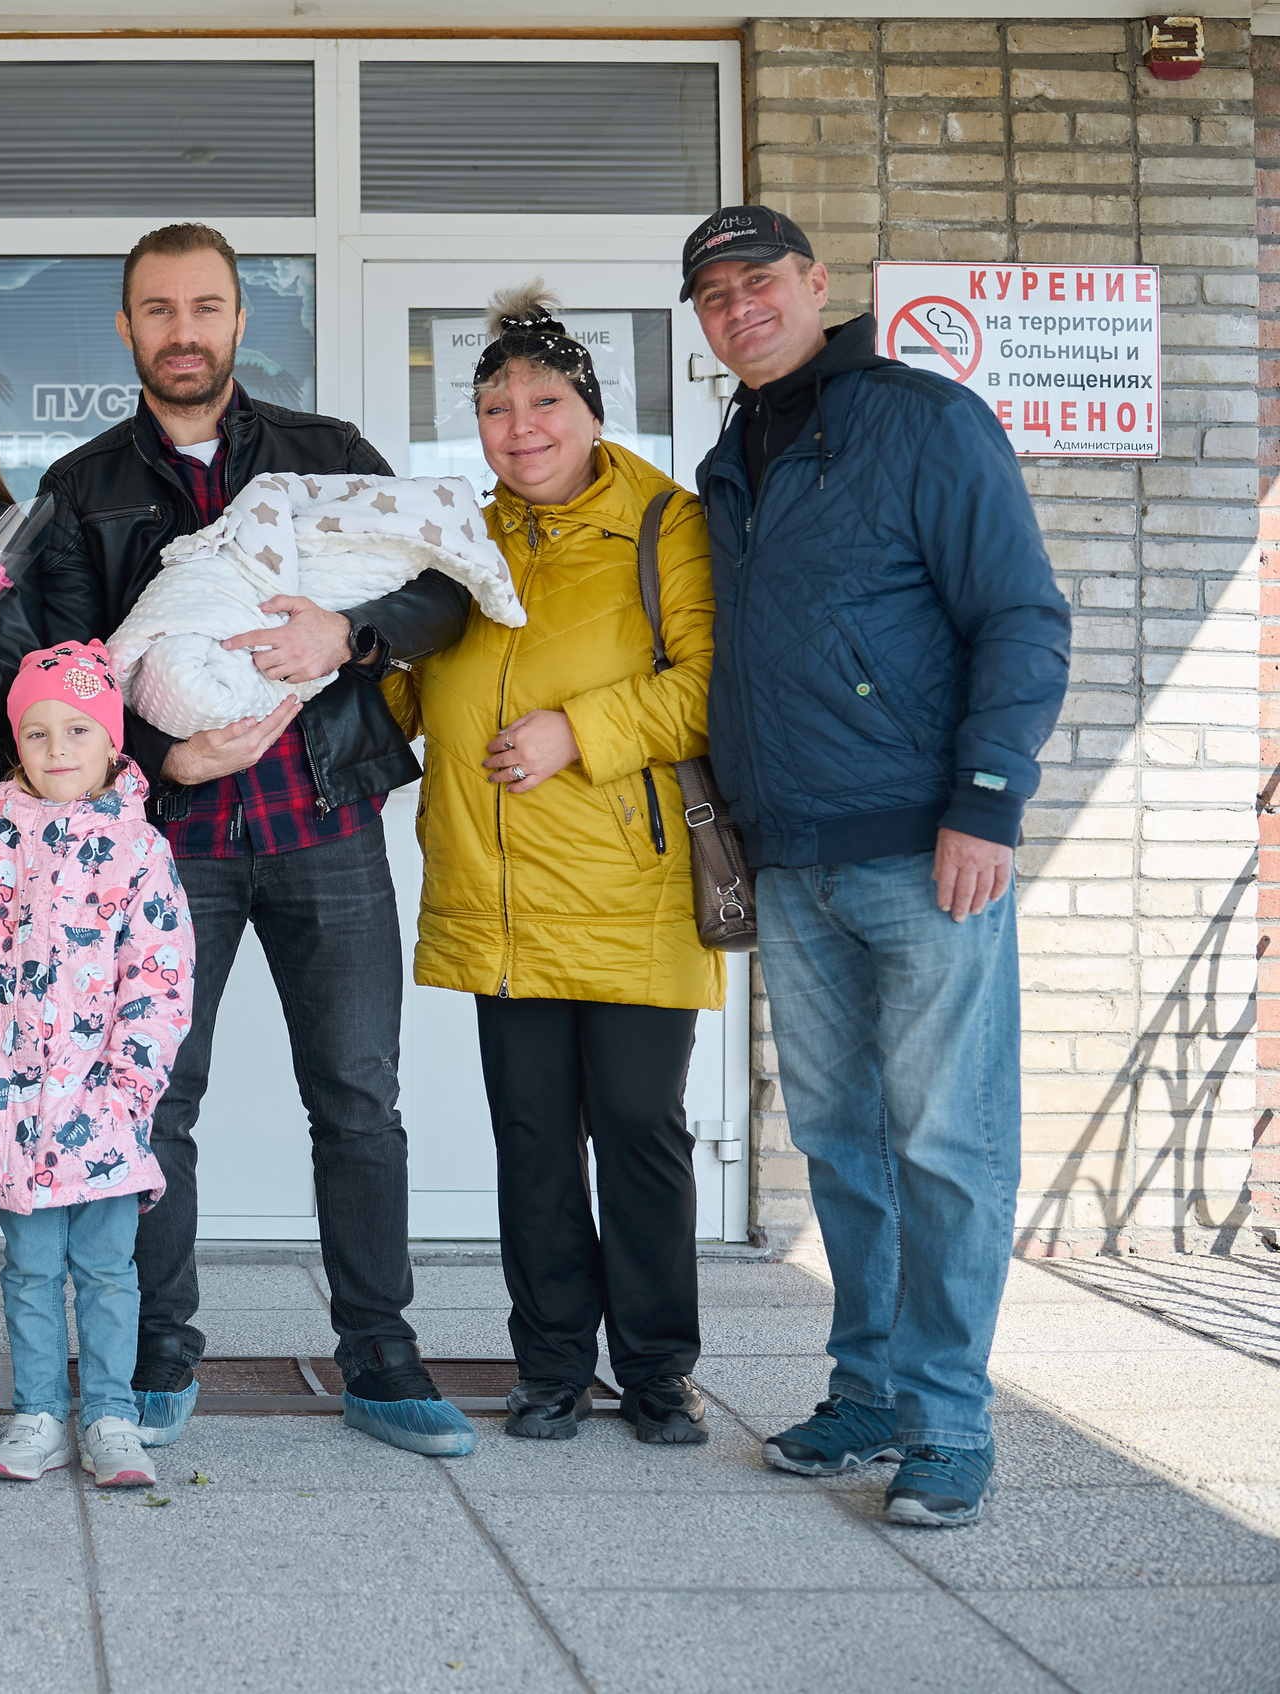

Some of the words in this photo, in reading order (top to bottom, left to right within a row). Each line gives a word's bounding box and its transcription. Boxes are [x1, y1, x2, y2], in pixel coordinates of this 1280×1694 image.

[969, 269, 1152, 303] КУРЕНИЕ
[985, 314, 1012, 331] на
[1017, 314, 1153, 336] территории
[999, 339, 1118, 363] больницы
[1126, 346, 1139, 361] и
[988, 372, 1001, 388] в
[1008, 371, 1153, 391] помещениях
[33, 383, 144, 422] ПУС
[996, 400, 1153, 437] ЕЩЕНО!
[1053, 439, 1153, 453] Администрация
